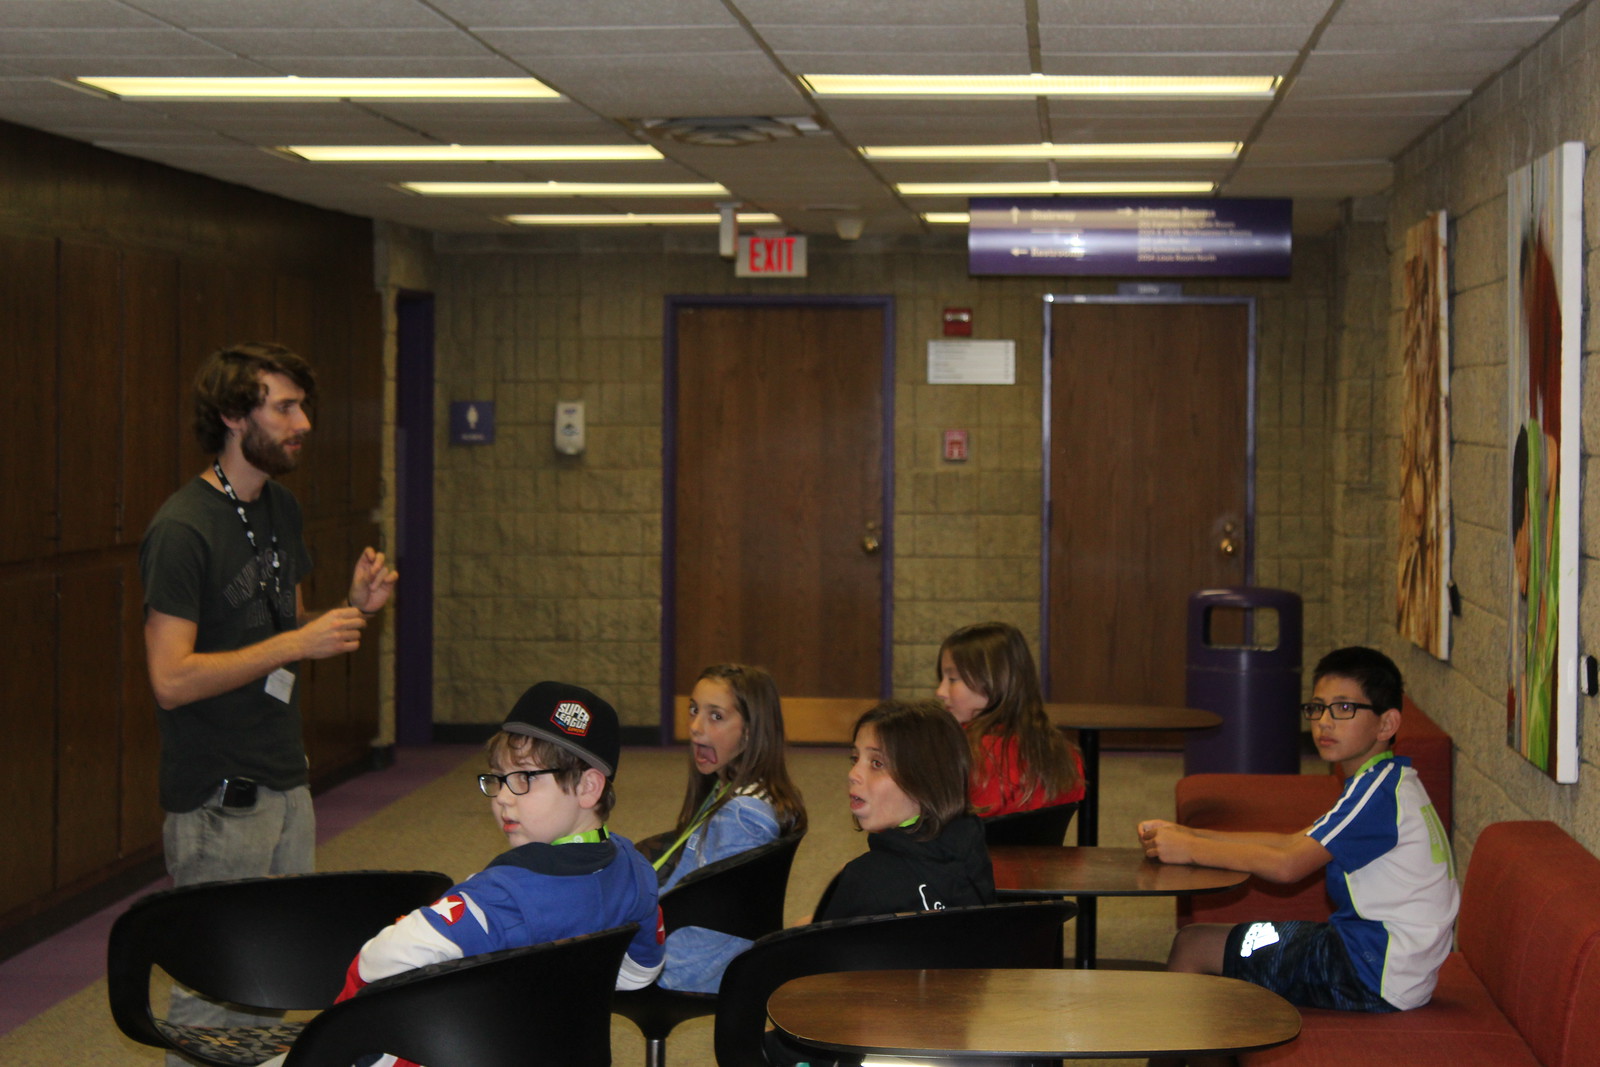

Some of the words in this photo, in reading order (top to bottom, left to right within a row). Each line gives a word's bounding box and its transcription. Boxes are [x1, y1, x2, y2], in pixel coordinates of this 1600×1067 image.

[749, 237, 796, 272] EXIT
[555, 711, 587, 730] LEAGUE
[558, 703, 590, 721] SUPER
